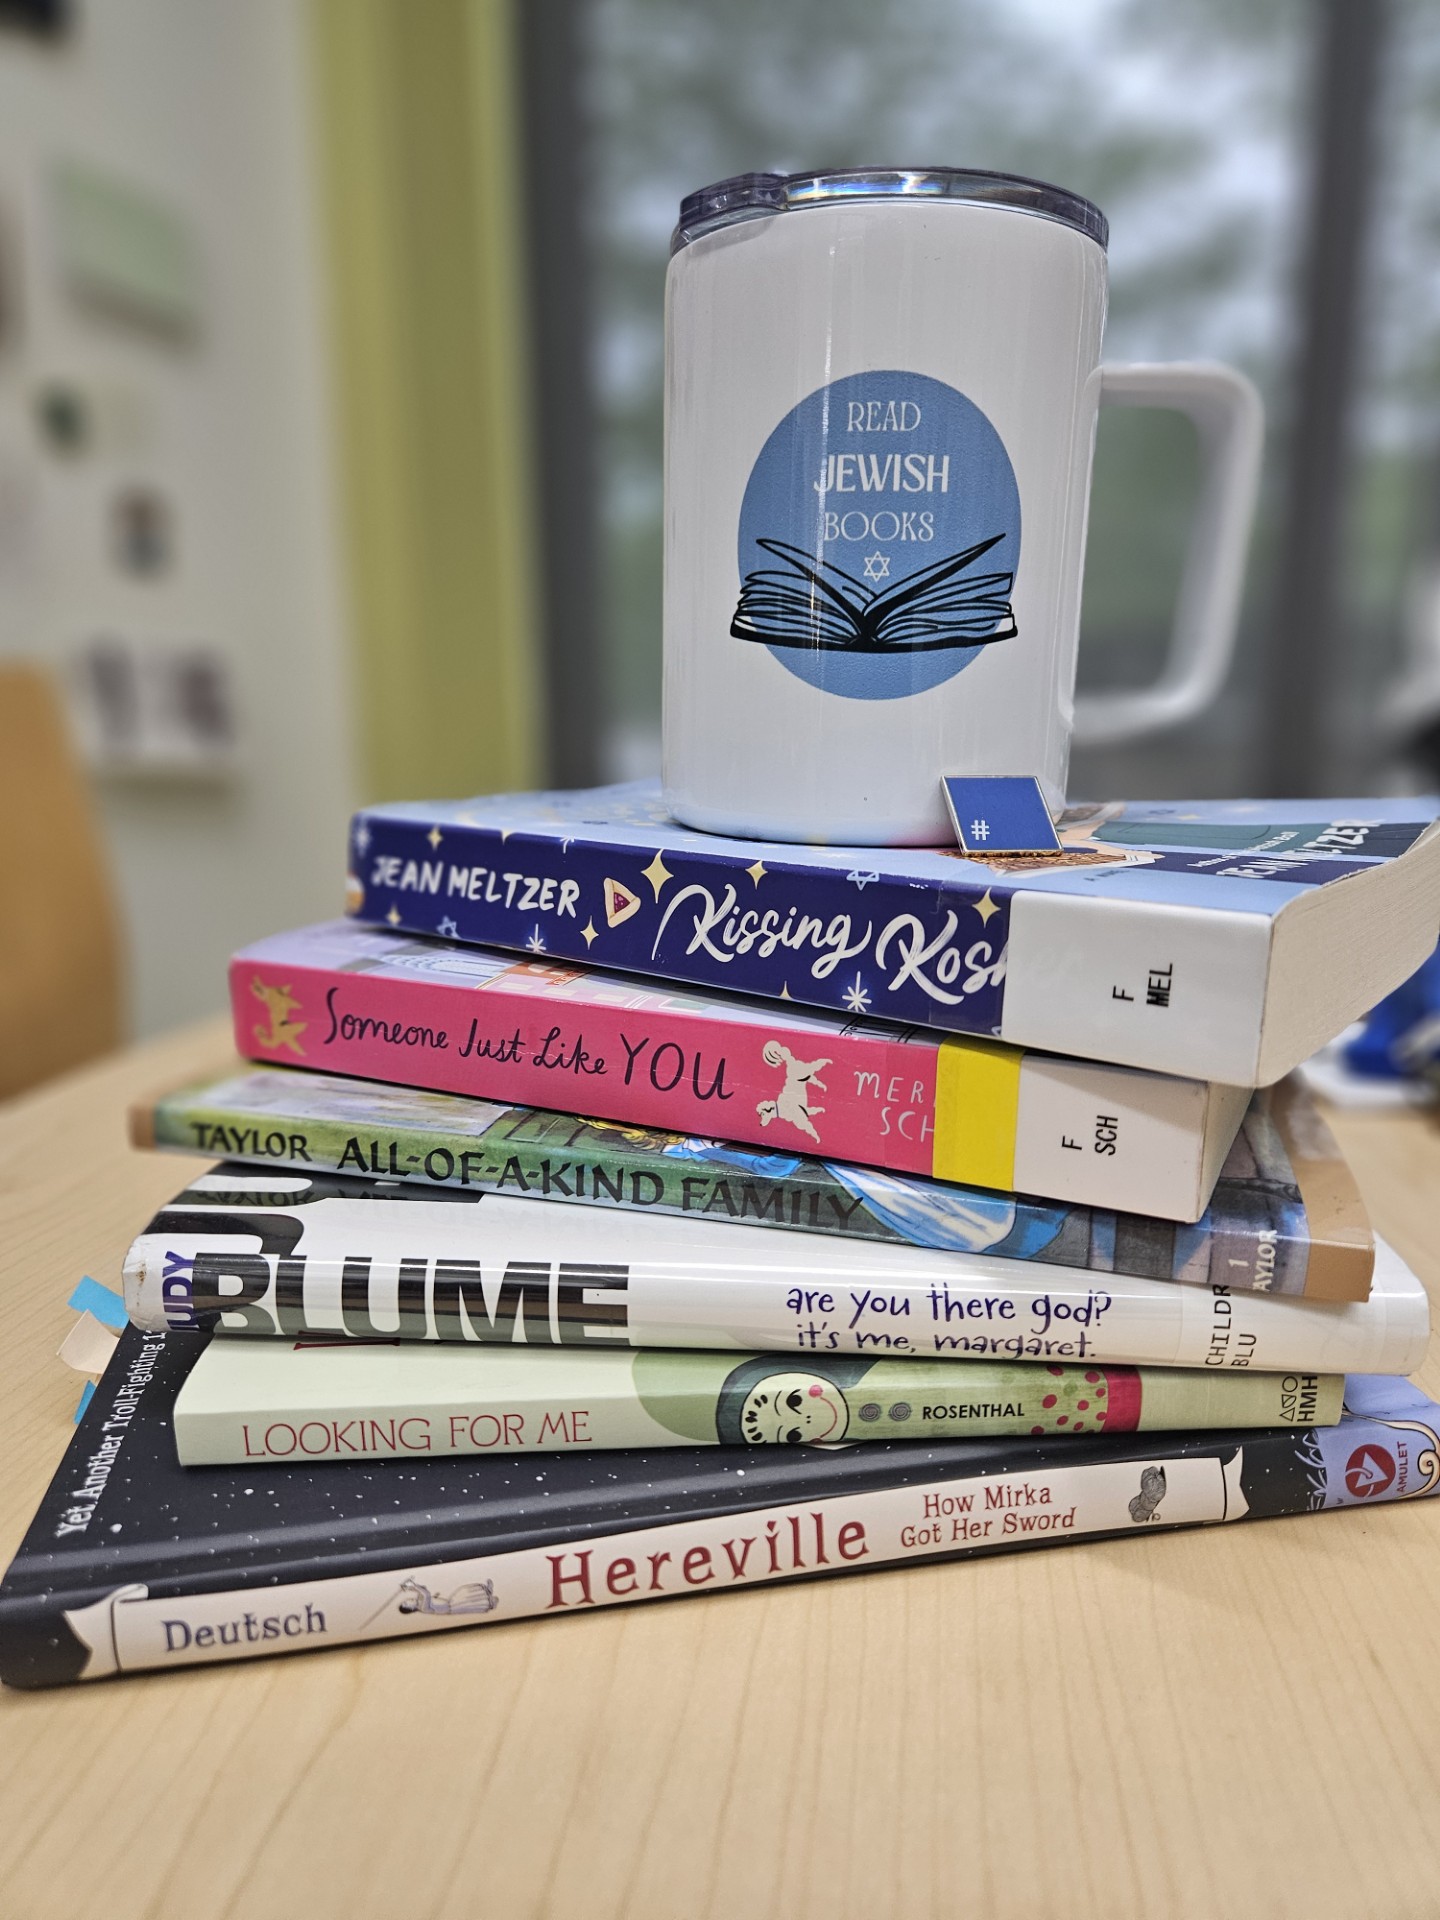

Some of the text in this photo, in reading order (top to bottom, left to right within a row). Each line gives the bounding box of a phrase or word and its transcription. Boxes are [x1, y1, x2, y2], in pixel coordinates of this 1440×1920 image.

[847, 401, 921, 432] READ
[813, 454, 950, 493] JEWISH
[823, 511, 934, 542] BOOKS
[970, 819, 990, 841] #
[370, 856, 580, 918] JEAN MELTZER
[651, 884, 872, 980] Kissing
[1112, 985, 1134, 1002] F
[1146, 963, 1173, 1008] MEL
[324, 987, 735, 1101] Someone Just Like YOU
[1061, 1135, 1083, 1151] F
[1094, 1114, 1118, 1156] SCH
[190, 1121, 313, 1163] TAYLOR
[336, 1137, 664, 1206] ALL-OF-A-KIND
[680, 1176, 864, 1231] FAMILY
[193, 1252, 630, 1346] BLUME
[786, 1282, 1112, 1335] are you there god?
[797, 1321, 1097, 1360] it's me, margaret.
[1204, 1284, 1231, 1366] CHILDR
[1231, 1333, 1257, 1367] BLU
[71, 1434, 125, 1500] Another
[102, 1342, 166, 1432] Troll-Fighting
[922, 1402, 1025, 1420] ROSENTHAL
[1297, 1375, 1318, 1423] HMH
[242, 1411, 593, 1457] LOOKING FOR ME
[1397, 1441, 1408, 1493] AMULET
[923, 1483, 1053, 1519] How Mirka
[901, 1506, 1078, 1548] Got Her Sword
[545, 1512, 870, 1609] Hereville
[160, 1602, 328, 1652] Deutsch
